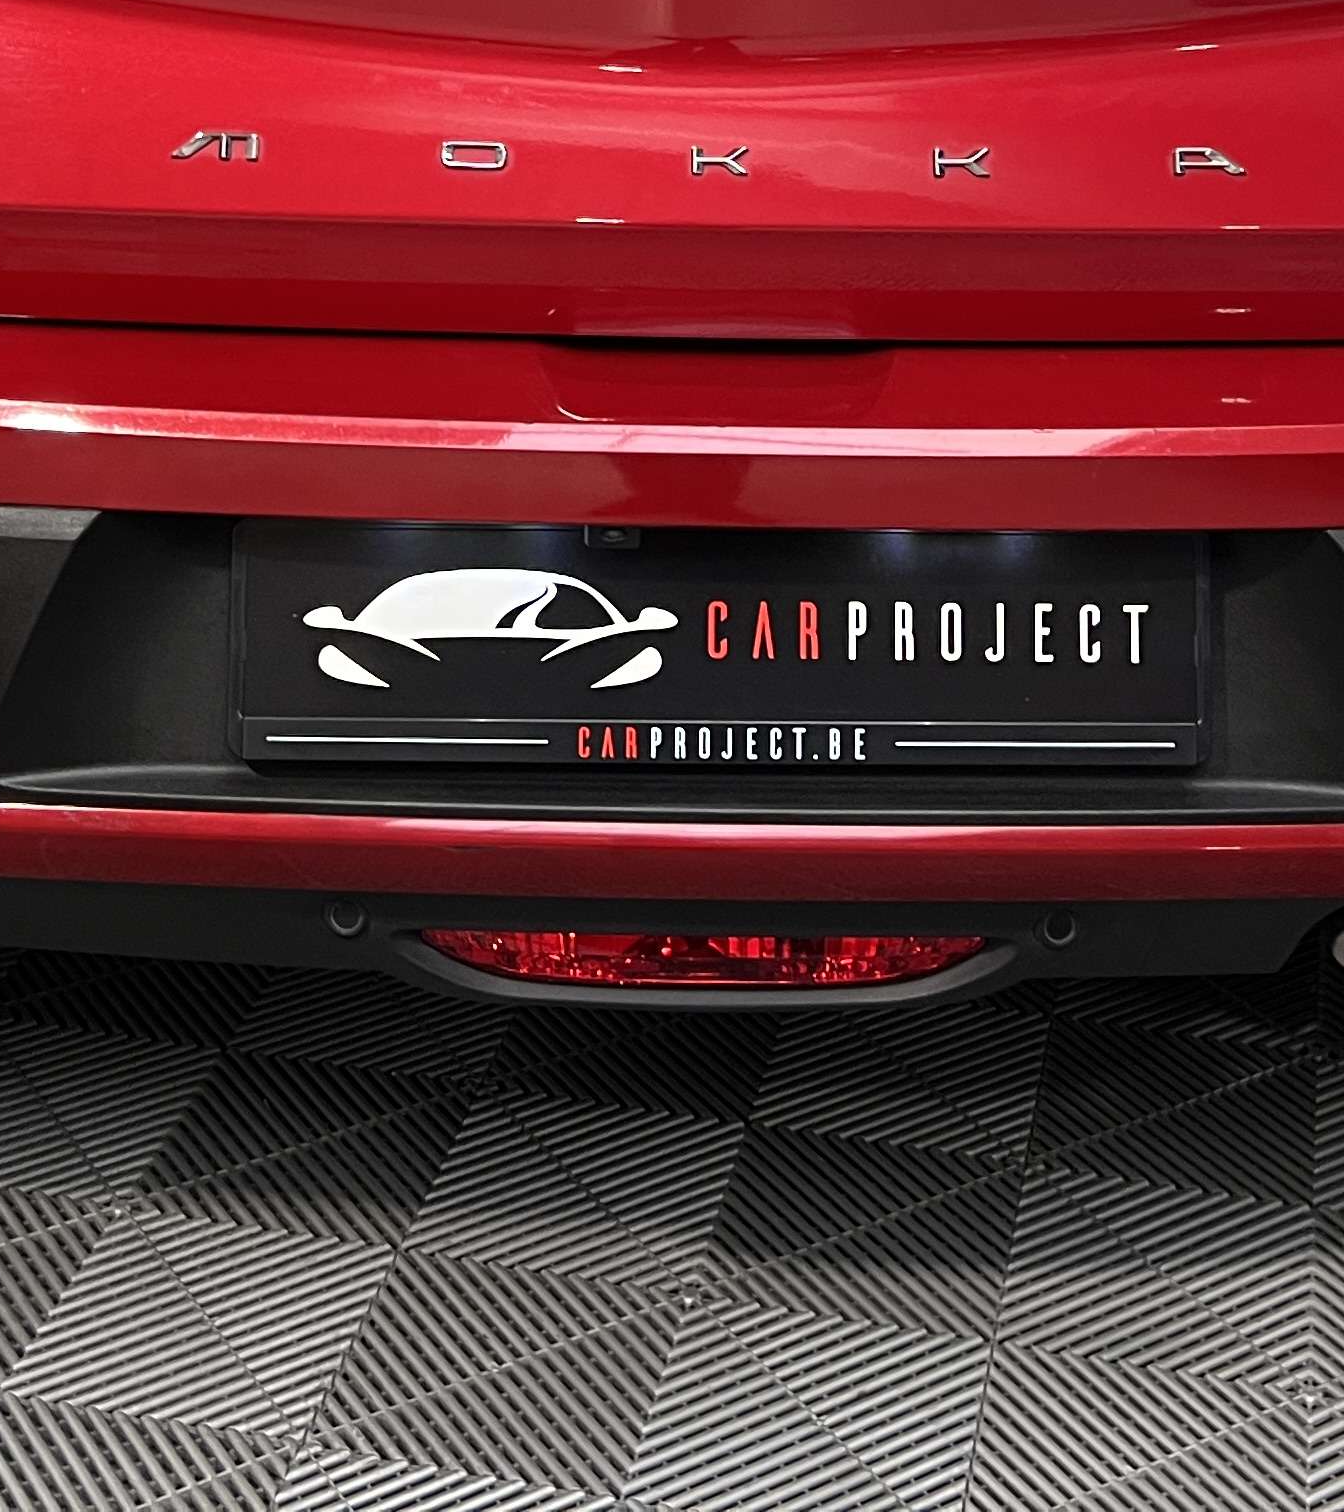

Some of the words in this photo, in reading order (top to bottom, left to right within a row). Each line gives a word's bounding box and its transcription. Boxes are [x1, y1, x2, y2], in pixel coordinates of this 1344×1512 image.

[171, 130, 1247, 176] MOKKA
[706, 600, 1150, 665] CARPROJECT
[576, 725, 868, 762] CARPROJECT.BE
